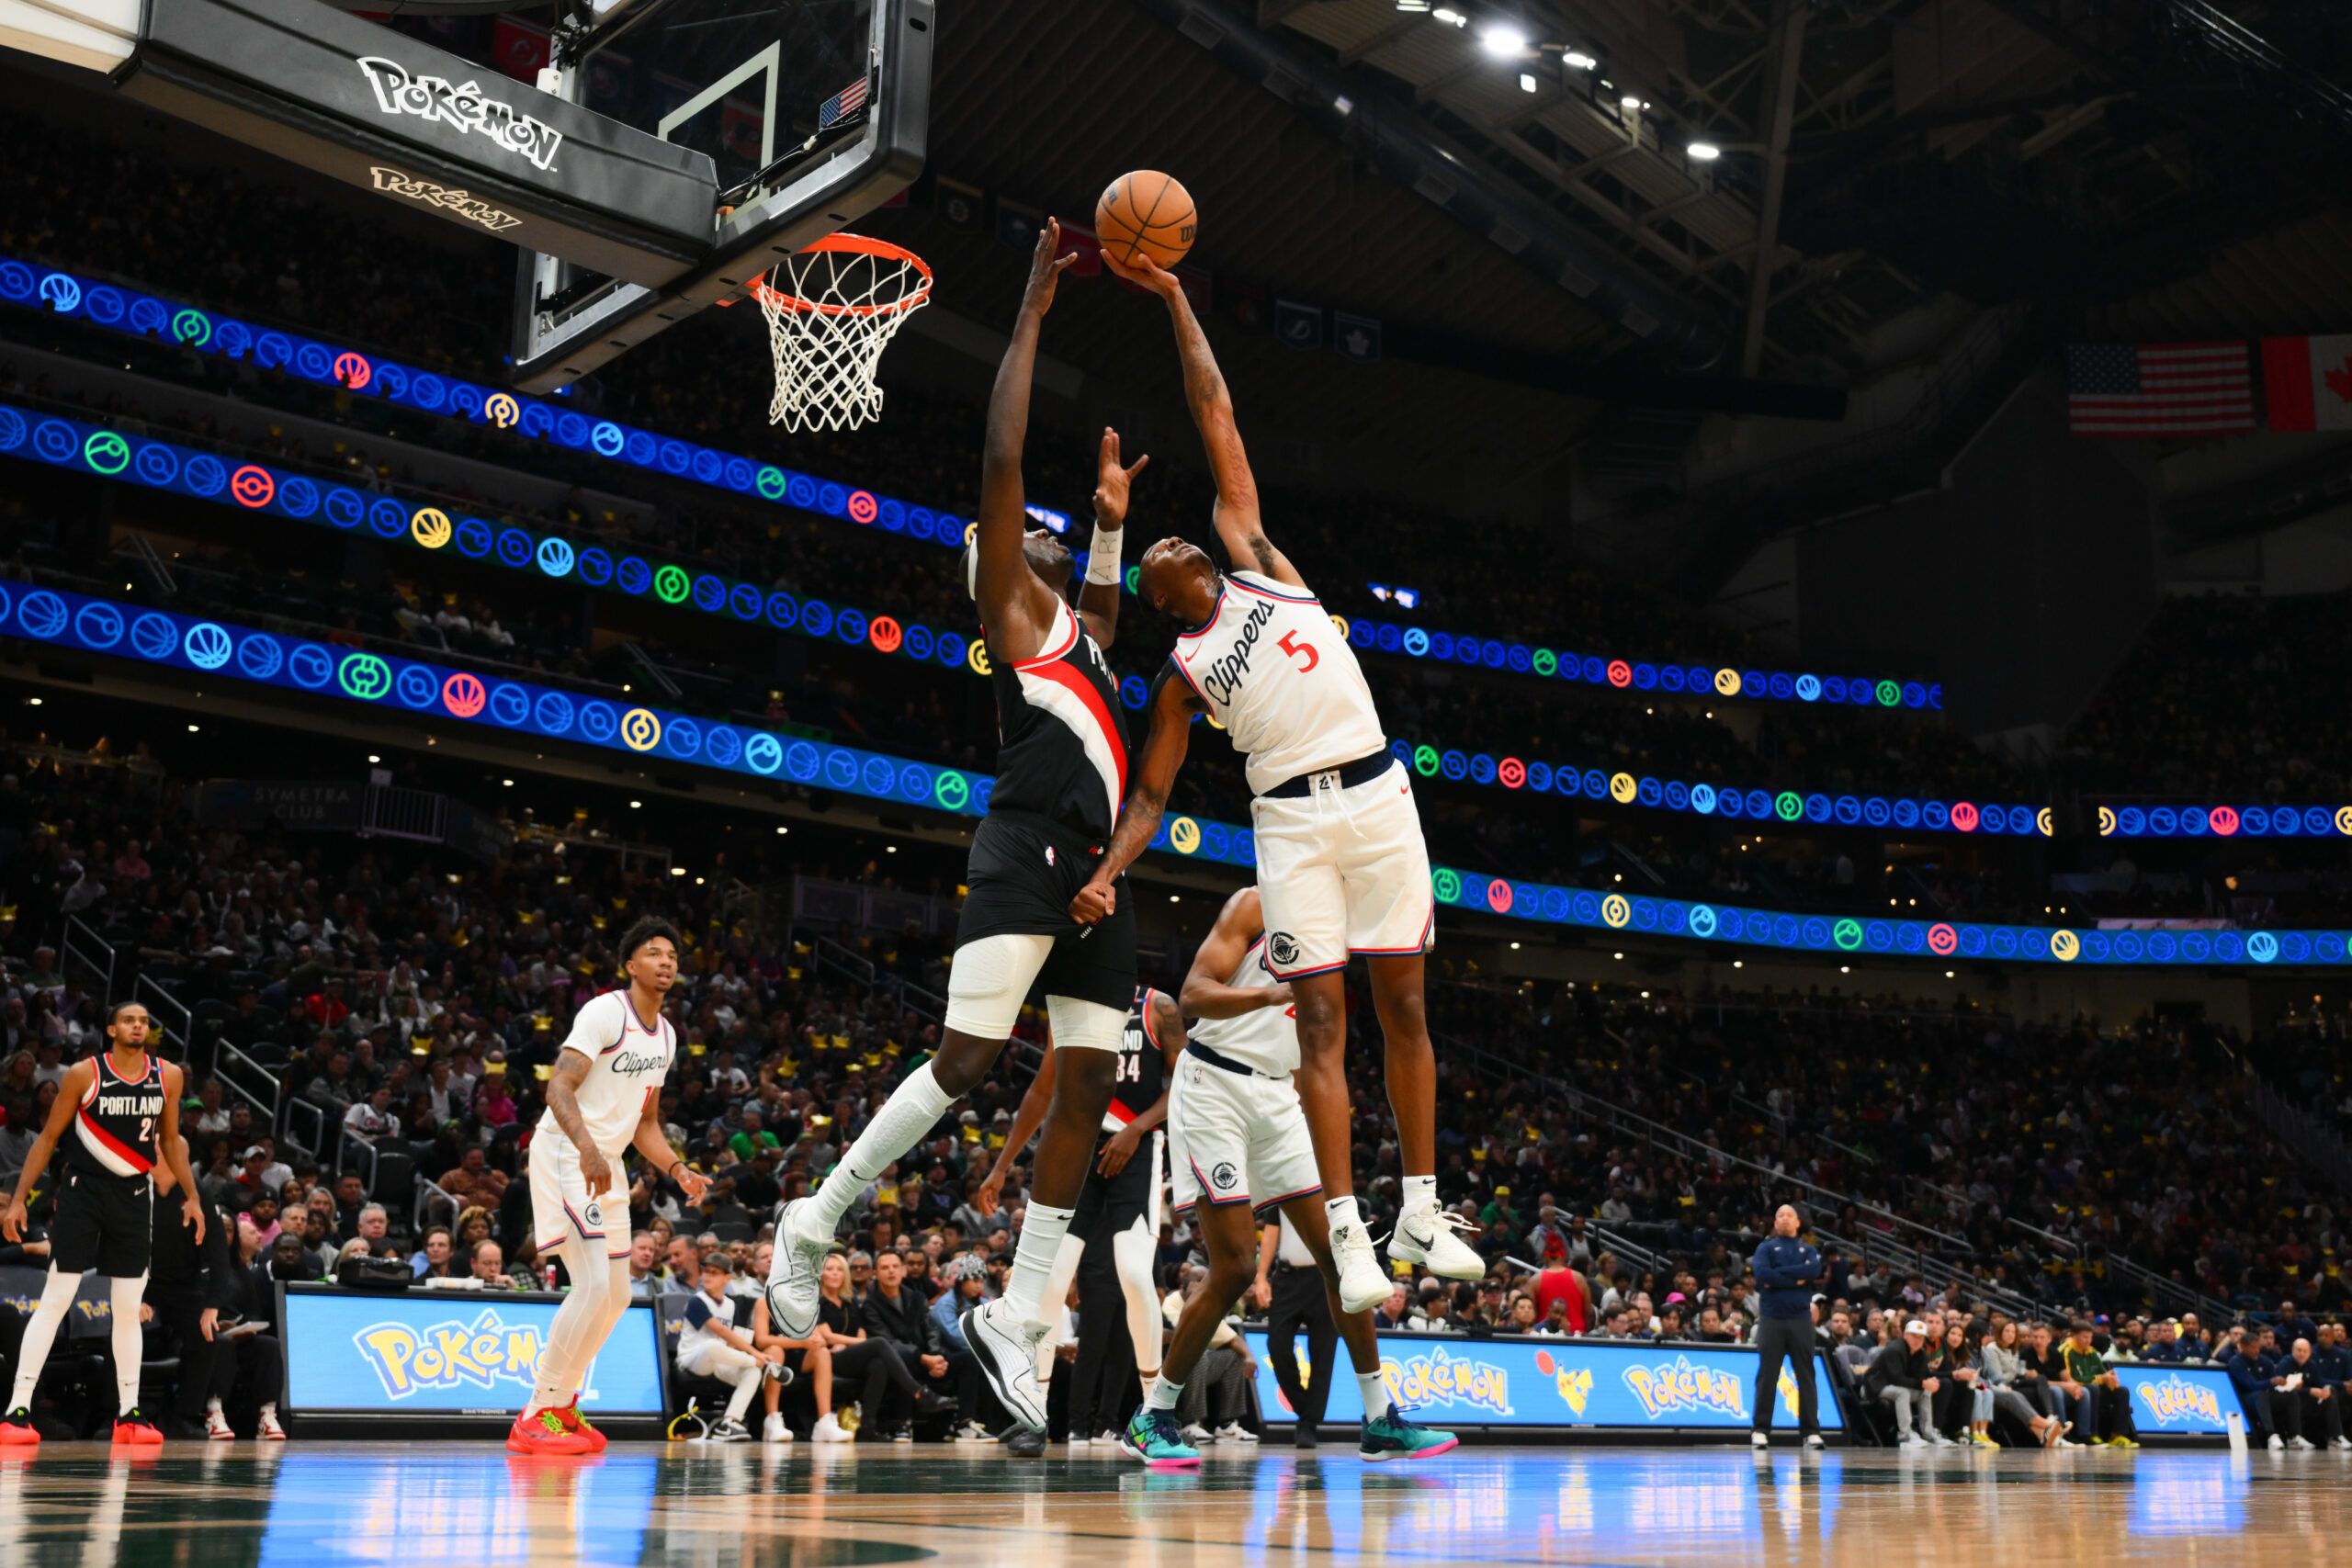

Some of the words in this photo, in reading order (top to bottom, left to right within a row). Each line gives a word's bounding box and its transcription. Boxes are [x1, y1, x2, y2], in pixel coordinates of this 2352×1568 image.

[1204, 600, 1275, 706] Clippers
[1277, 629, 1319, 673] 5
[254, 786, 350, 803] SYMETRA
[275, 804, 326, 819] CLUB
[98, 1096, 164, 1115] PORTLAND
[139, 1116, 156, 1142] 2
